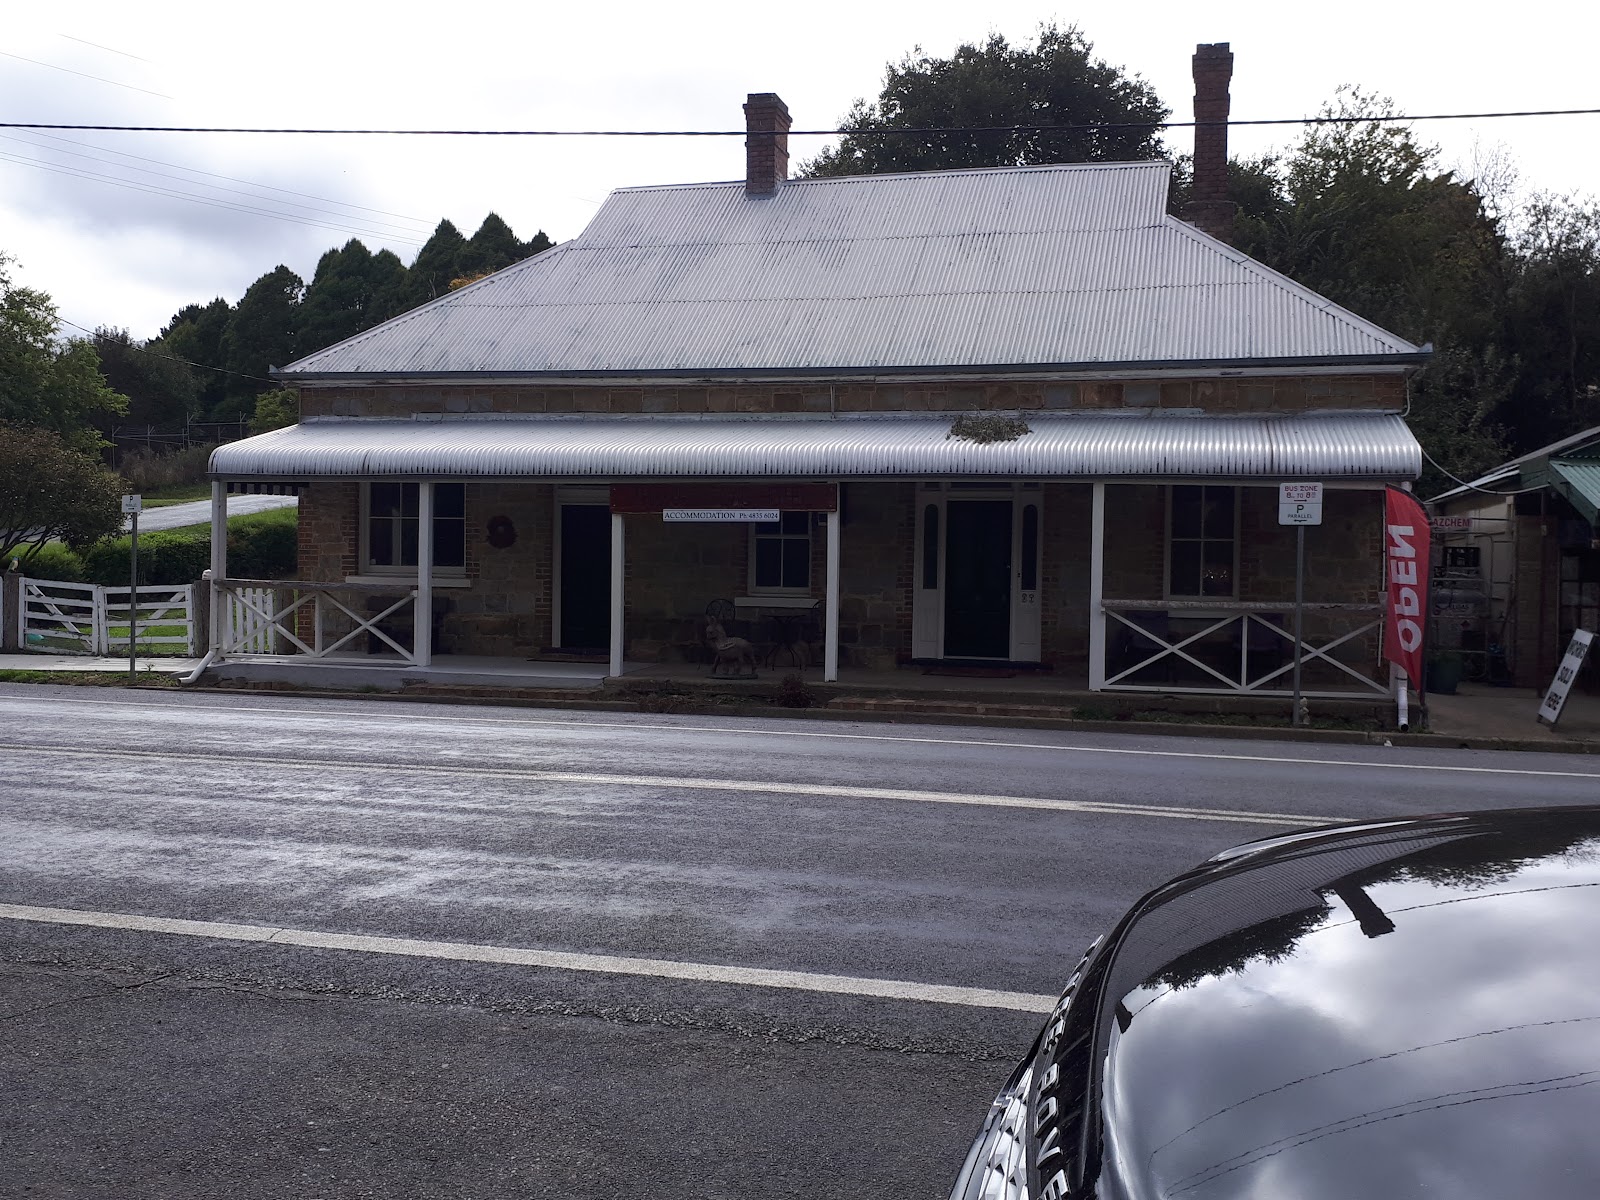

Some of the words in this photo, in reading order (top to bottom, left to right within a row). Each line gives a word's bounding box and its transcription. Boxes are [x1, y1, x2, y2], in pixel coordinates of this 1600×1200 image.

[1297, 505, 1304, 513] P
[664, 511, 736, 519] ACCOMMODATION
[1431, 518, 1470, 527] AZCHEM
